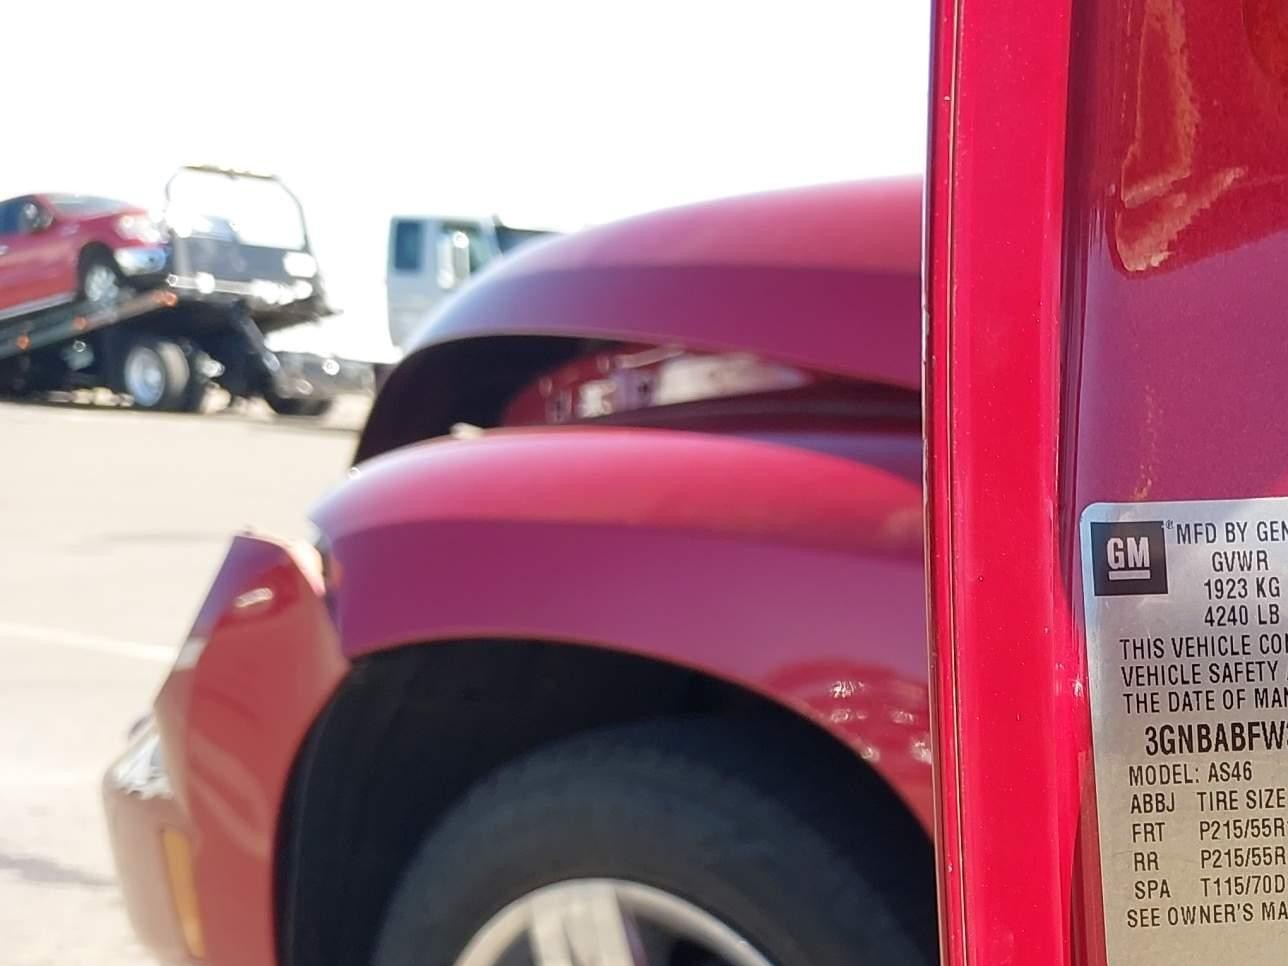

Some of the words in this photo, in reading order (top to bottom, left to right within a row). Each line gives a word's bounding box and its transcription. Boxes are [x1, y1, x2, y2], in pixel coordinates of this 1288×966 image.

[1177, 523, 1216, 544] MFD
[1226, 522, 1248, 543] BY
[1106, 537, 1150, 569] GM
[1212, 550, 1268, 573] GVWR
[1204, 578, 1248, 600] 1923
[1256, 577, 1280, 598] KG
[1205, 605, 1249, 627] 4240
[1258, 604, 1280, 624] LB
[1120, 637, 1164, 660] THIS
[1171, 634, 1251, 658] VEHICLE
[1122, 664, 1201, 688] VEHICLE
[1209, 660, 1278, 684] SAFETY
[1123, 693, 1160, 714] THE
[1169, 690, 1215, 712] DATE
[1223, 689, 1246, 710] OF
[1129, 764, 1199, 786] MODEL:
[1208, 761, 1252, 783] AS46
[1130, 792, 1176, 814] ABBJ
[1197, 790, 1239, 812] TIRE
[1246, 788, 1286, 809] SIZE
[1132, 821, 1165, 843] FRT
[1134, 851, 1159, 872] RR
[1135, 879, 1170, 900] SPA
[1127, 908, 1161, 928] SEE
[1167, 903, 1254, 927] OWNER'S
